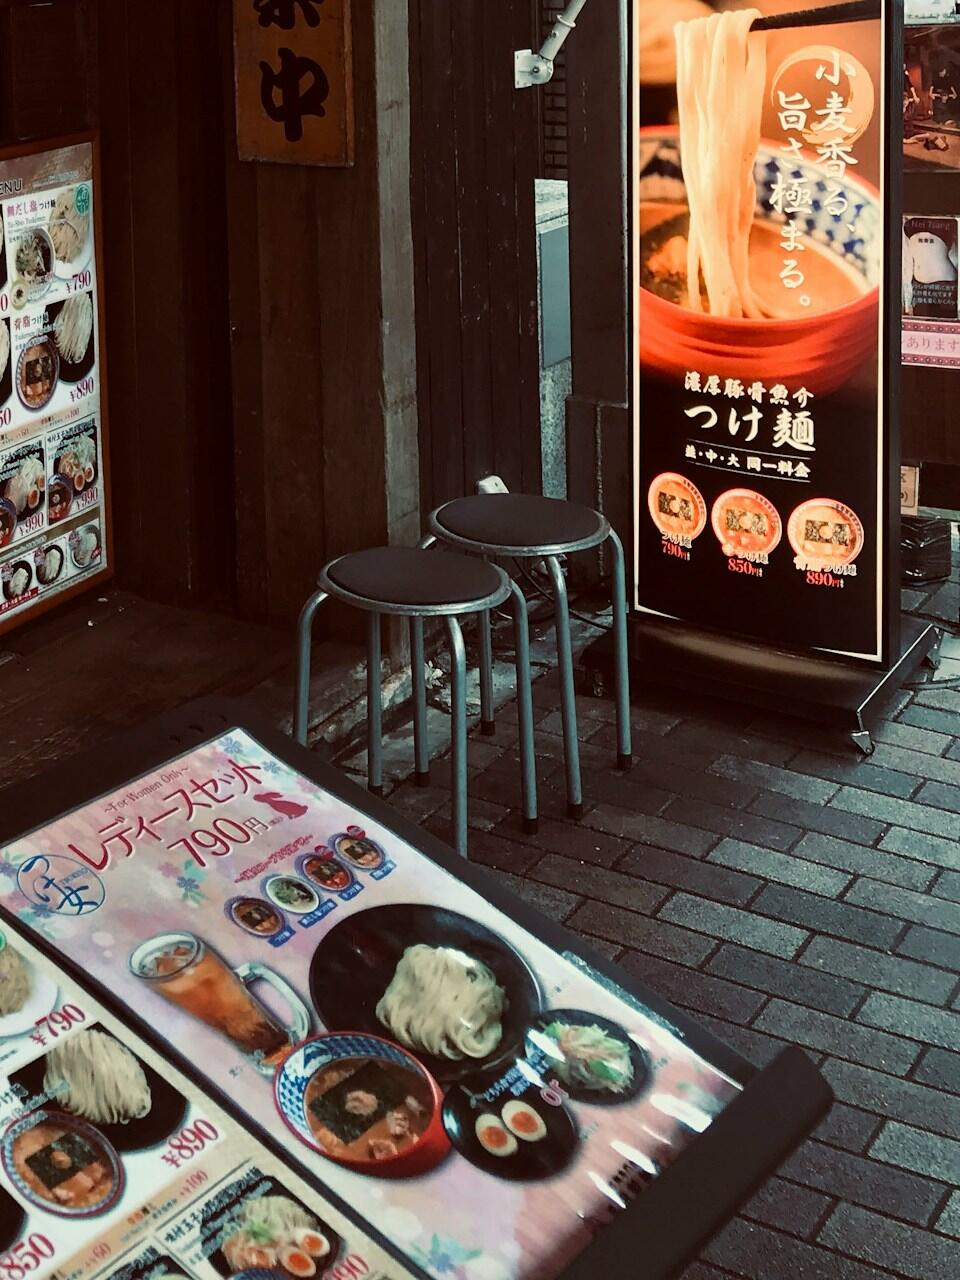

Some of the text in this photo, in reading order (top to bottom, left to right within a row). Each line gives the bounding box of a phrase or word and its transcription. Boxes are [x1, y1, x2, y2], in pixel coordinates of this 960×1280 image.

[809, 51, 859, 233] 小麦香る、
[769, 89, 813, 307] 旨さ極まる。
[65, 270, 91, 294] ¥790
[69, 376, 95, 403] ¥890
[684, 371, 815, 408] 濃厚豚骨魚介
[683, 404, 817, 452] つけ麺
[746, 456, 812, 479] 同一料金
[68, 758, 262, 872] レディースセット
[127, 779, 162, 807] Women
[166, 815, 270, 868] 790円
[29, 1003, 86, 1047] ¥790
[160, 1118, 219, 1168] ¥890
